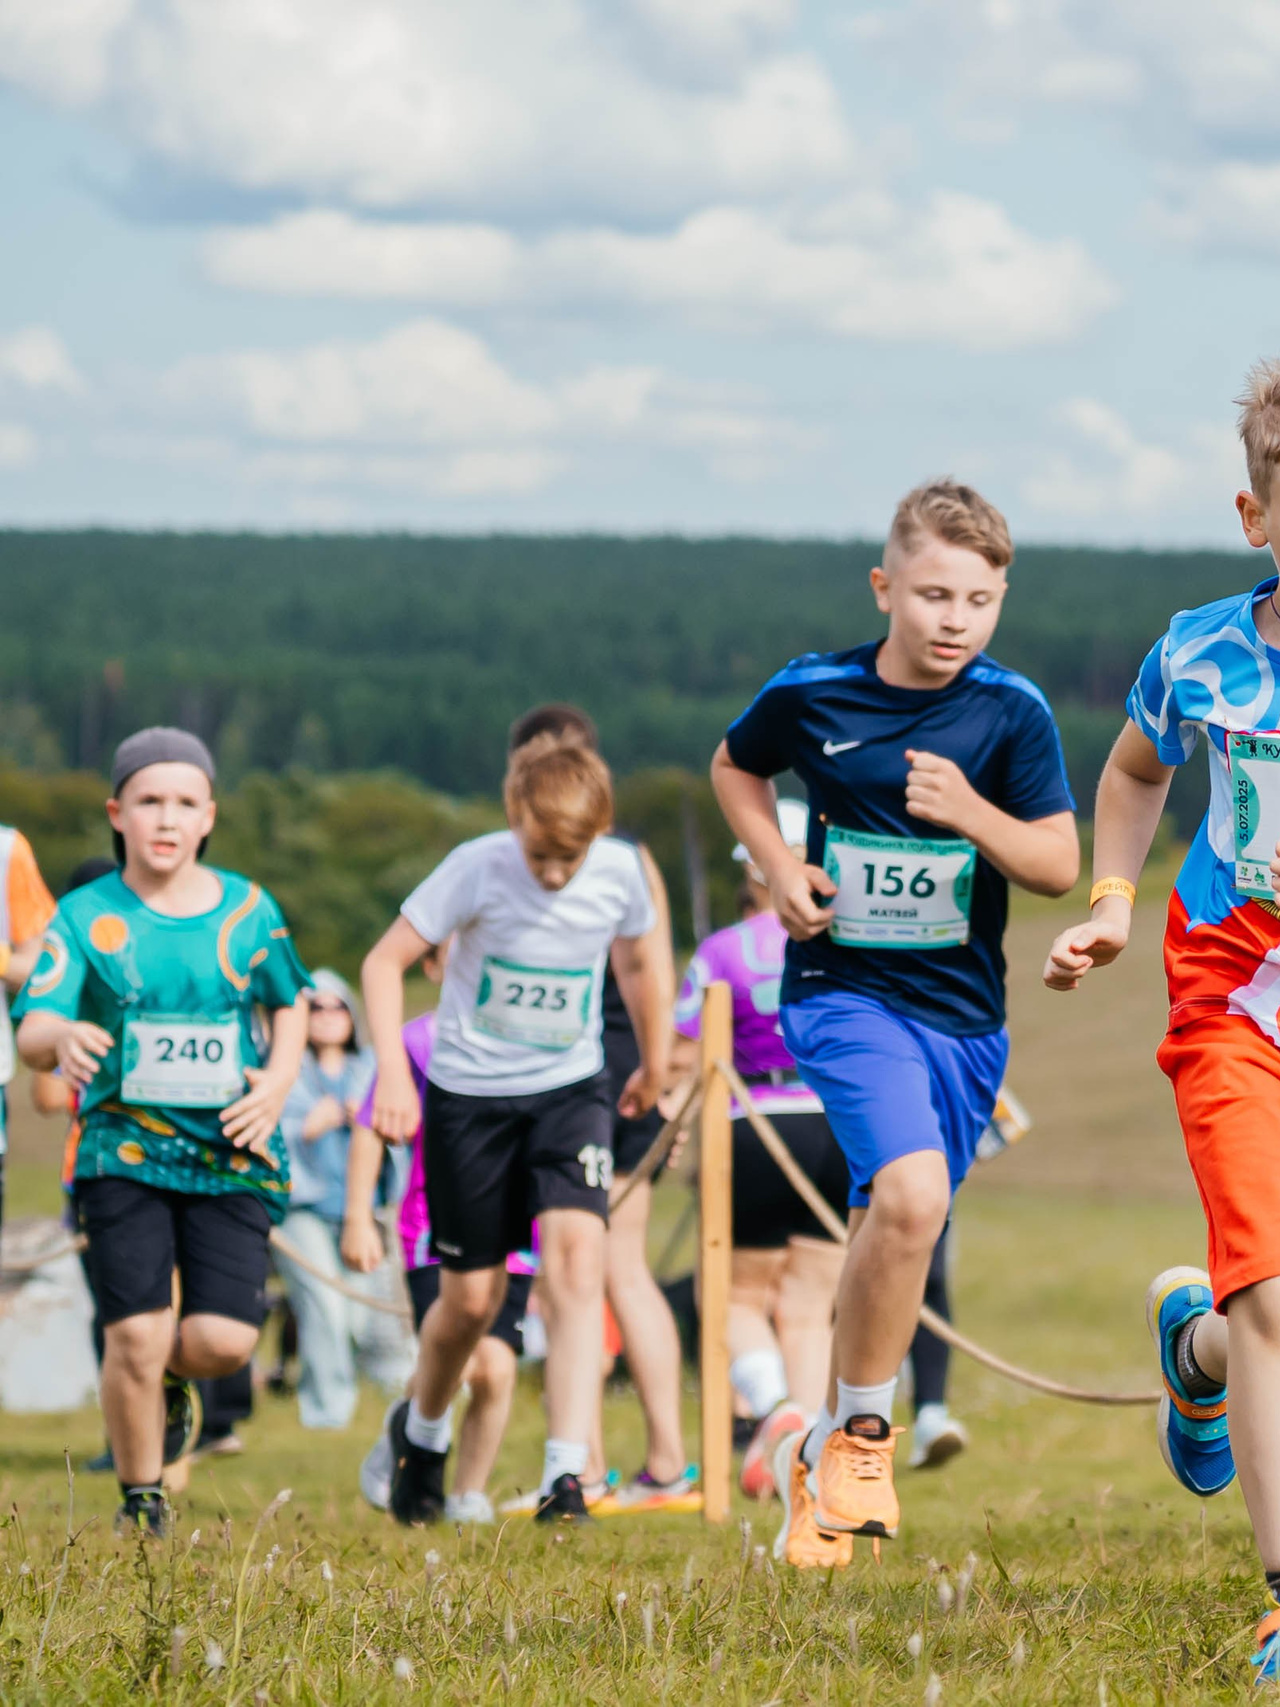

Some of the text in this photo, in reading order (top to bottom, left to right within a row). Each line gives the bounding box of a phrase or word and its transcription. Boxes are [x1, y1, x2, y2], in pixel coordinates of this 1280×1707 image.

[1238, 779, 1249, 842] 5.07.2025
[862, 863, 936, 899] 156
[505, 983, 568, 1012] 225
[155, 1037, 224, 1063] 240
